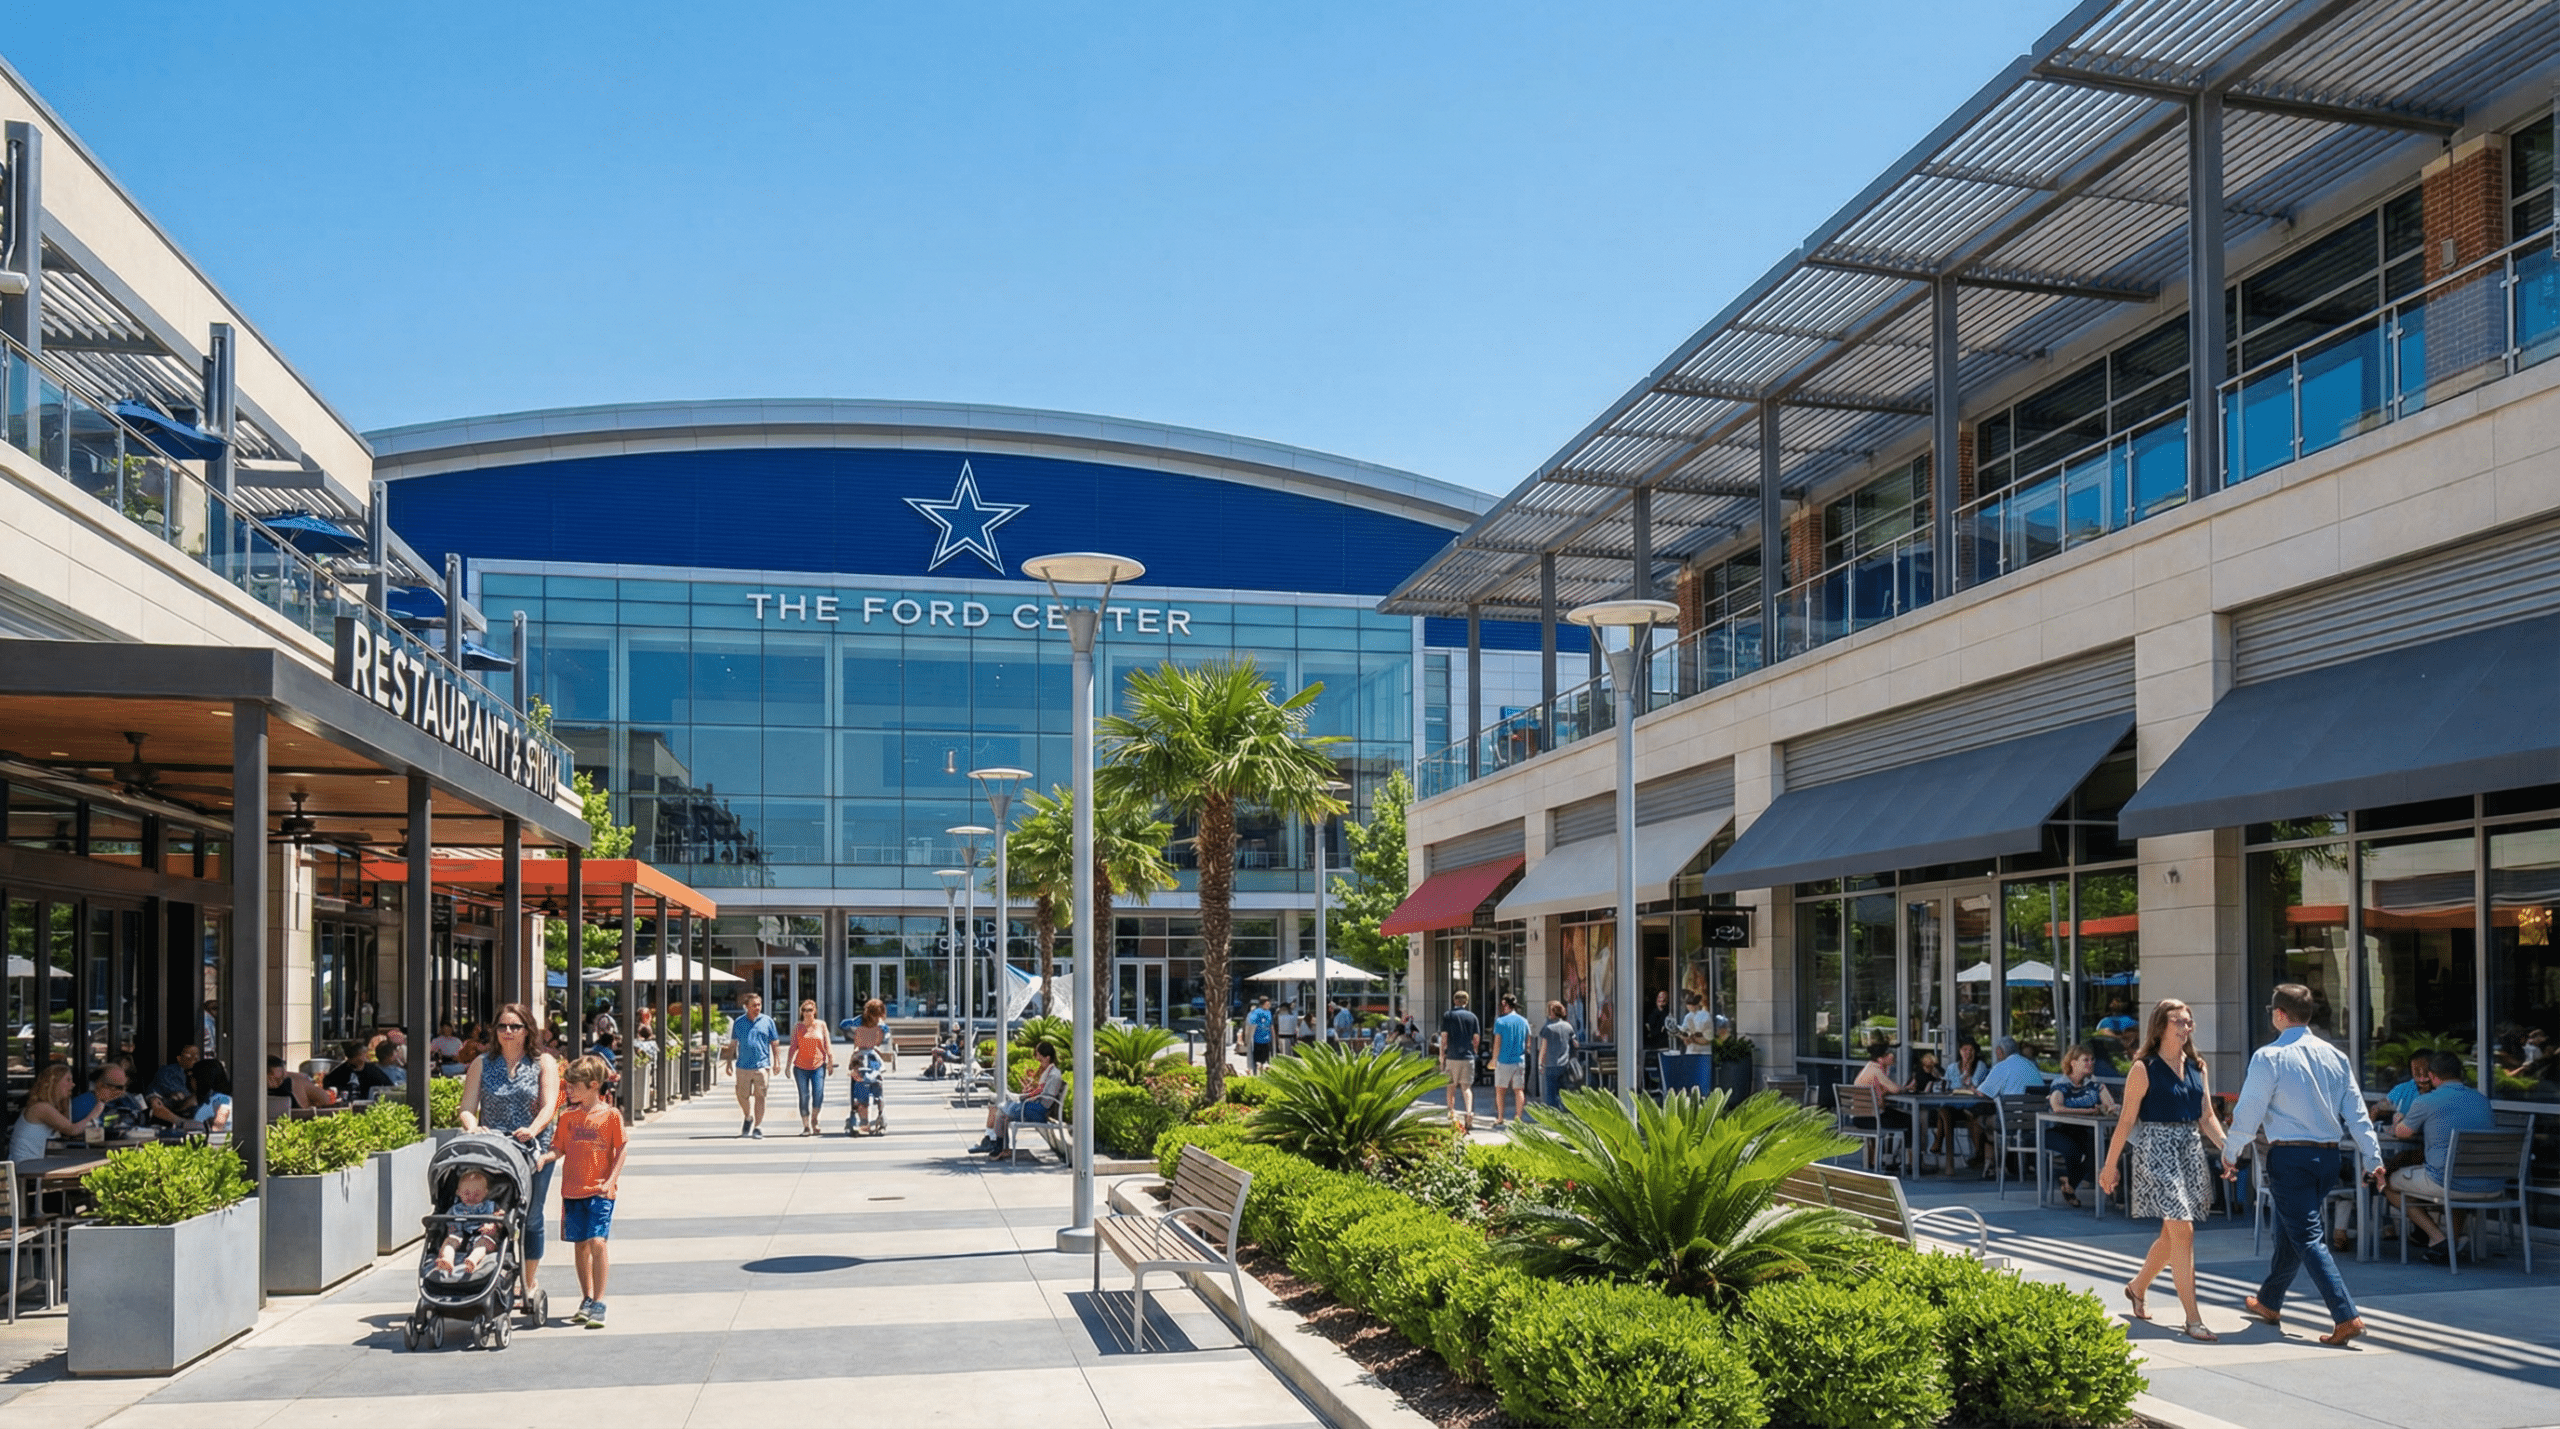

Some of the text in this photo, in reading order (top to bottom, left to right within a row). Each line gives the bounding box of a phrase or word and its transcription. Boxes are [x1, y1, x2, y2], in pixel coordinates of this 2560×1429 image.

[746, 593, 1192, 636] THE FORD CETER
[352, 618, 509, 775] RESTAURANT
[511, 726, 522, 784] &
